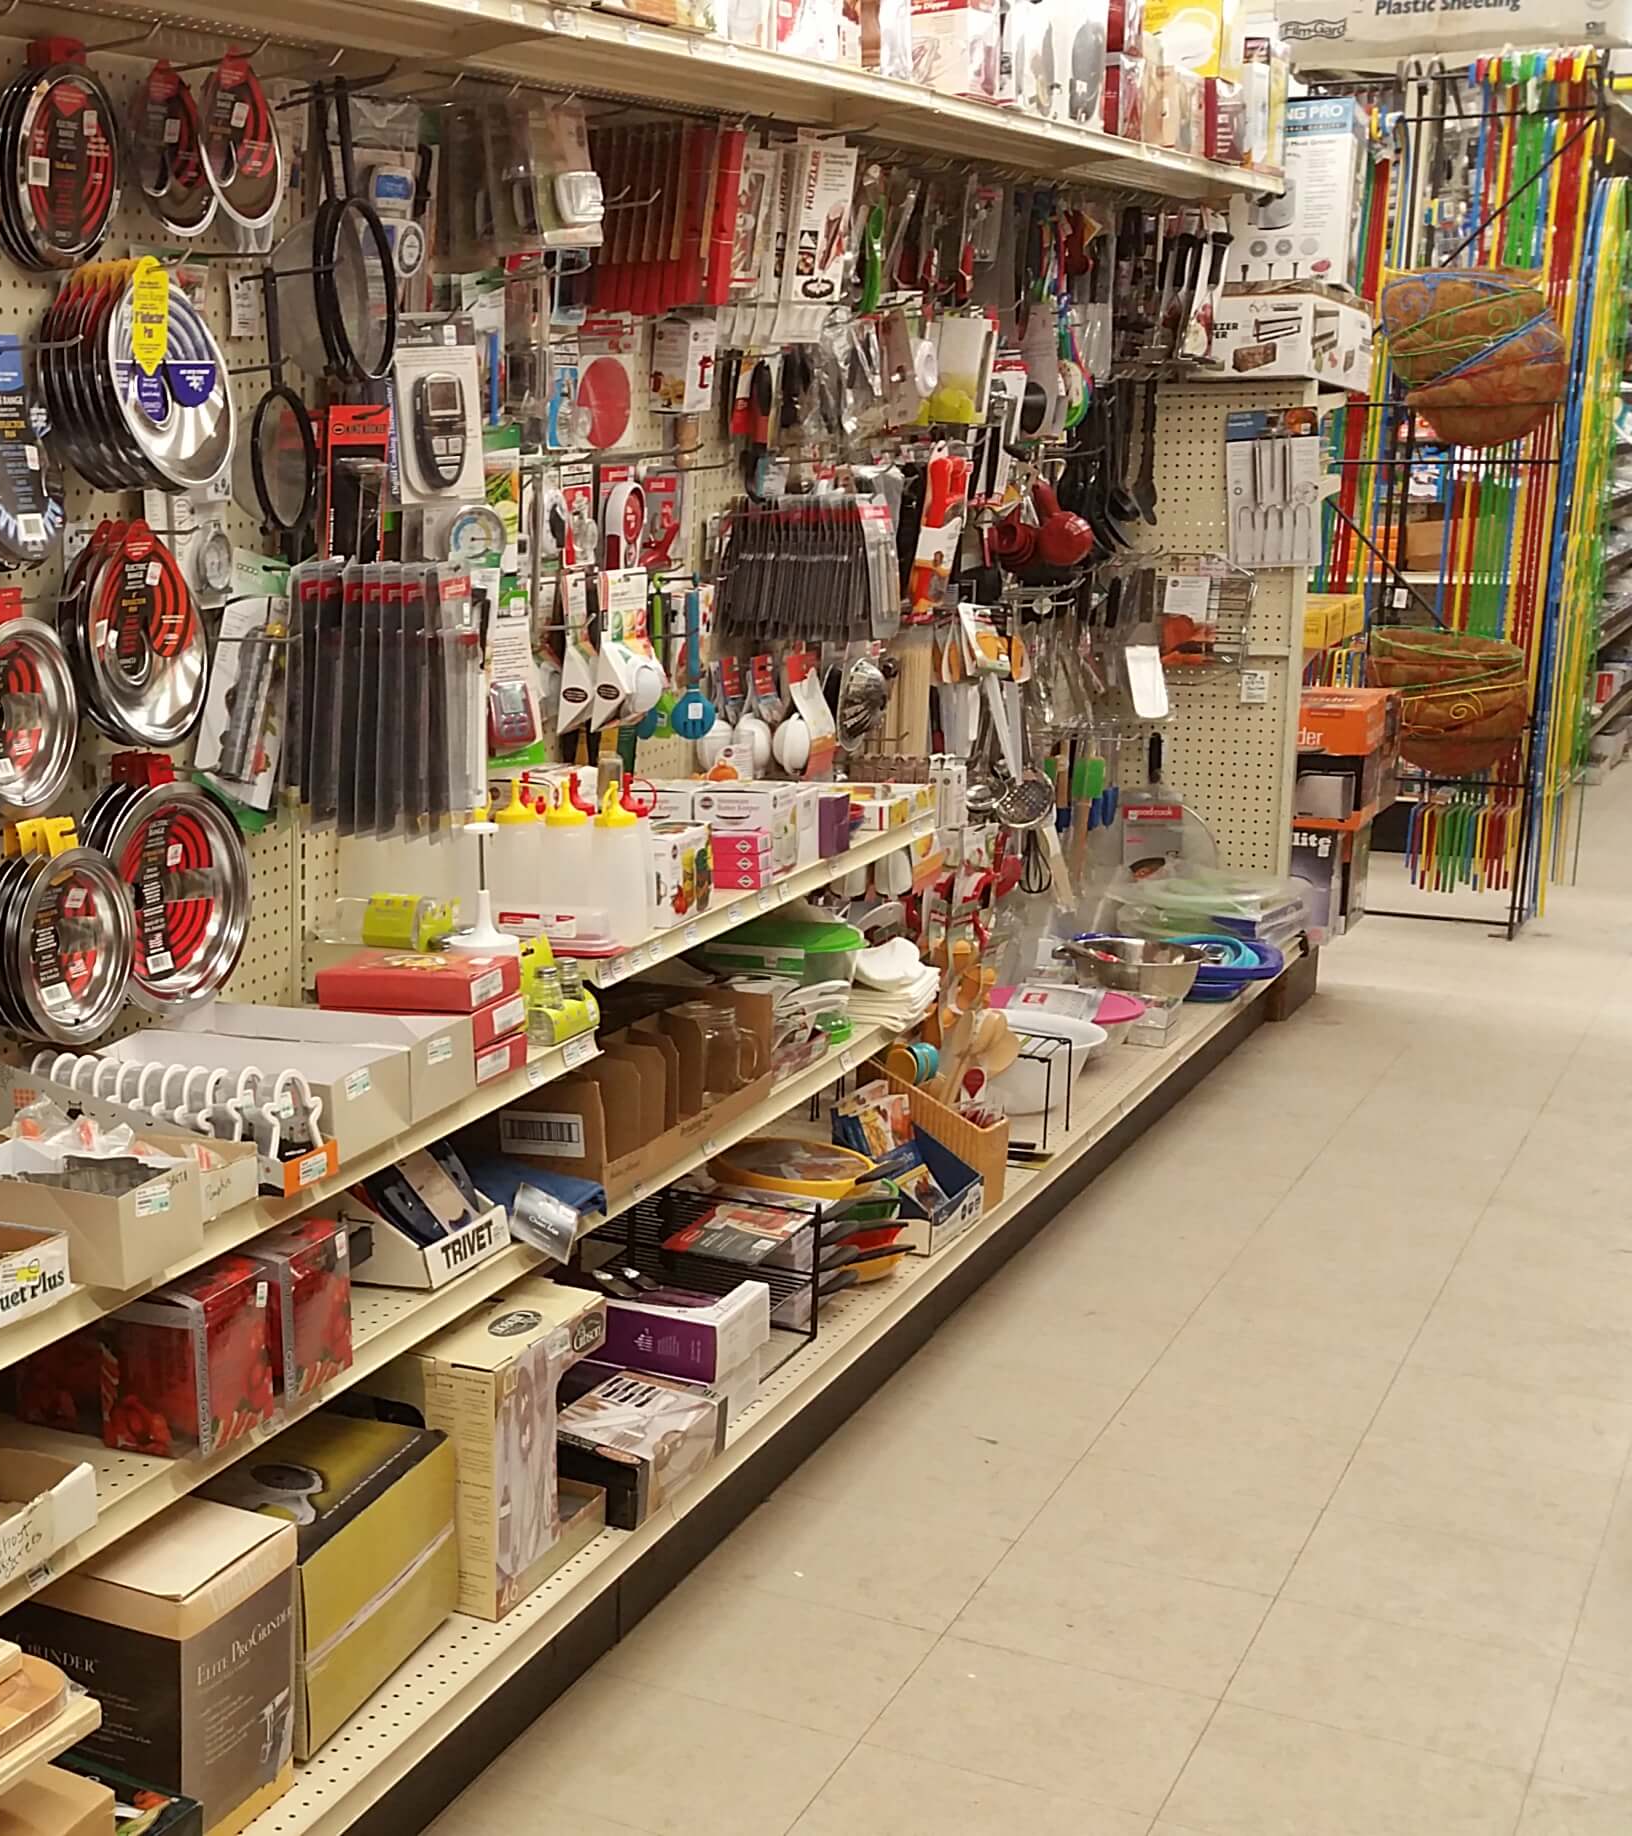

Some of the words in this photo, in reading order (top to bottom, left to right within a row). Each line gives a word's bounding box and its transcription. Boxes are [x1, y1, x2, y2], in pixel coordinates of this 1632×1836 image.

[1284, 21, 1346, 38] Film-Gard
[1310, 104, 1344, 120] PRO
[805, 151, 821, 211] HUTZLER
[1297, 727, 1323, 745] der
[441, 1220, 494, 1270] TRIVET
[30, 1270, 65, 1299] Plus
